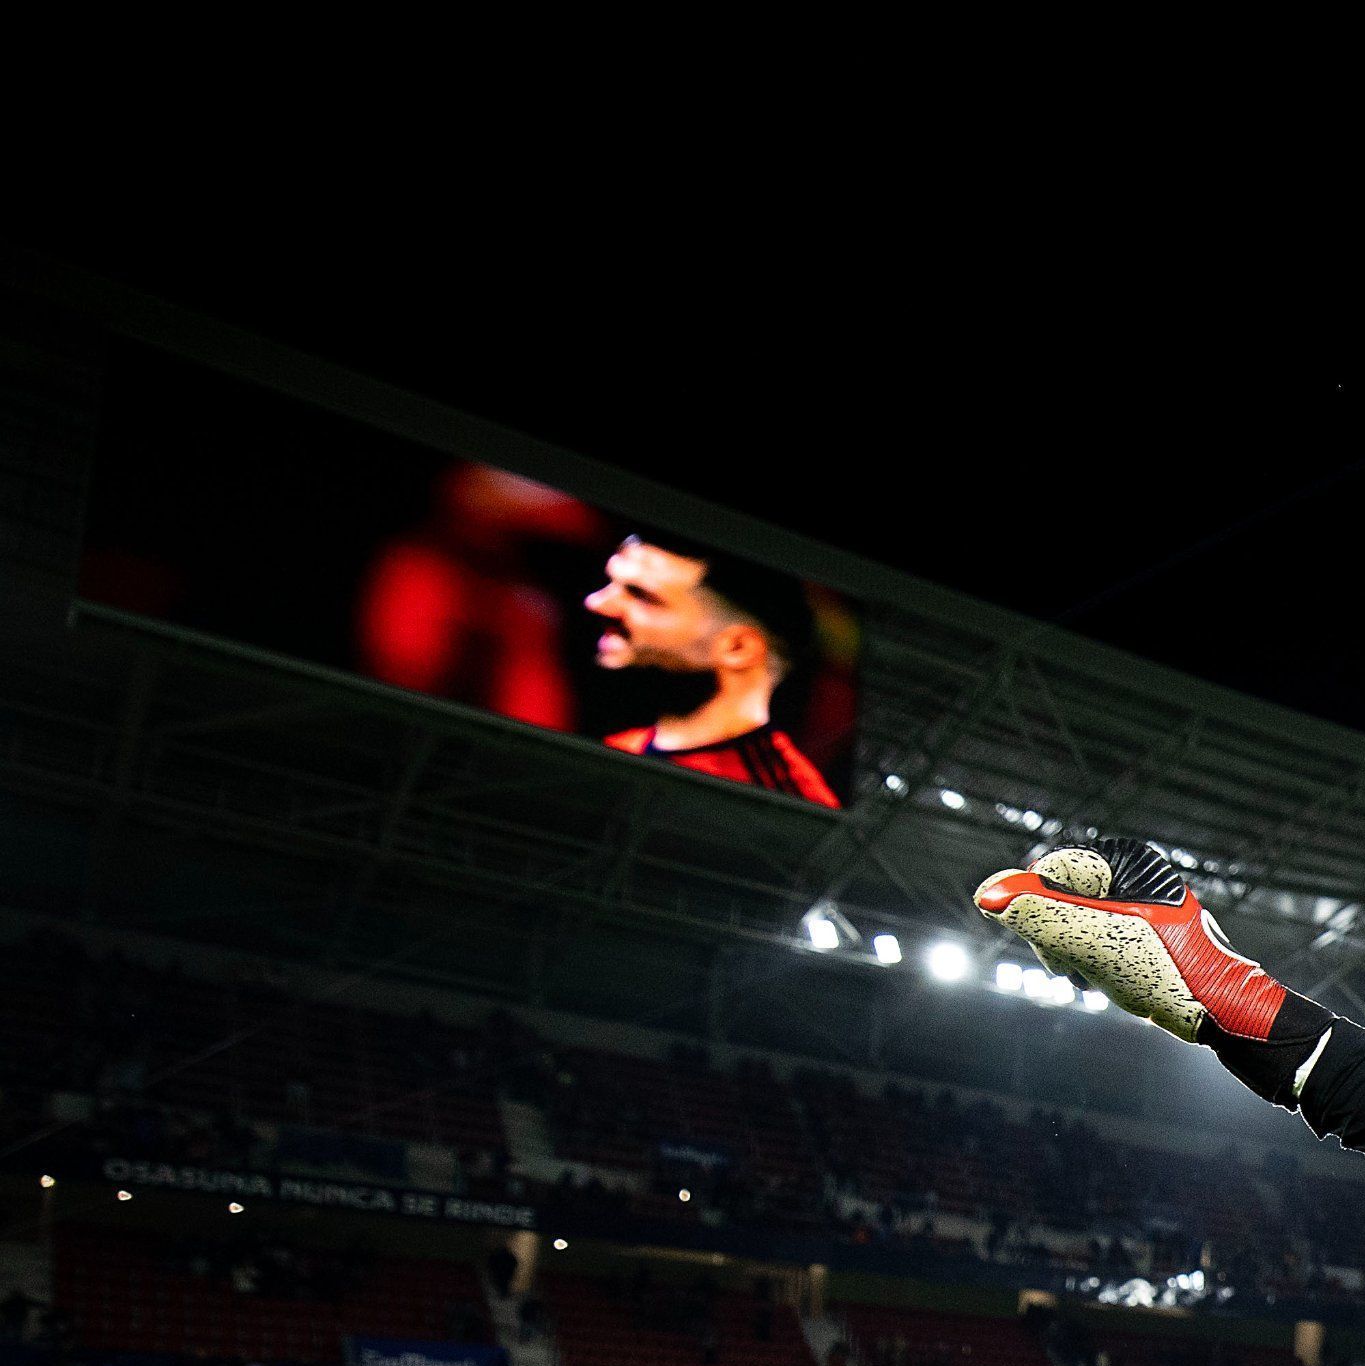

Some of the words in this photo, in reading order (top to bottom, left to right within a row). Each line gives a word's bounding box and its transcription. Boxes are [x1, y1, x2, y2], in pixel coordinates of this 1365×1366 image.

[102, 1157, 273, 1198] OSASUNA
[279, 1178, 396, 1214] NUNCA
[401, 1193, 439, 1218] SE
